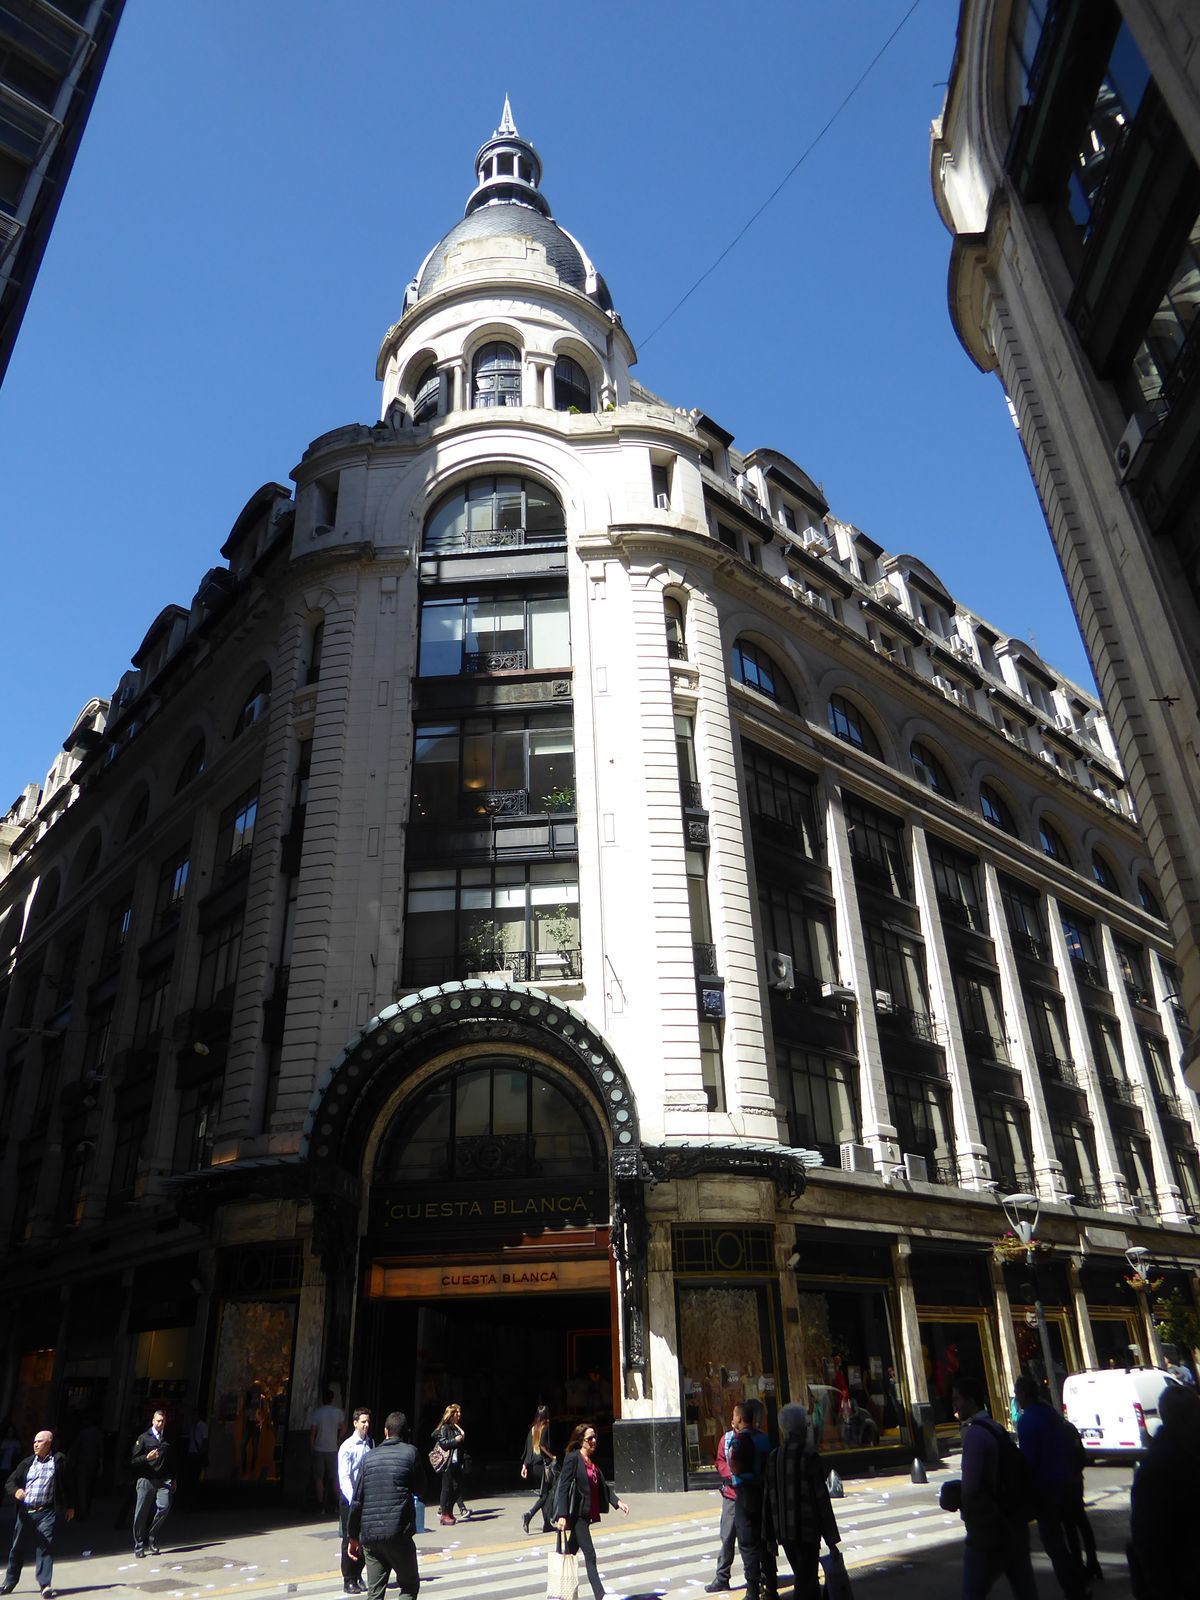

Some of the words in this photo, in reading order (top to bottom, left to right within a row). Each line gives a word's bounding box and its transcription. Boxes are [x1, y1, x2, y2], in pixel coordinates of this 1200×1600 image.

[390, 1201, 483, 1220] CUESTA
[493, 1196, 588, 1215] BLANCA
[441, 1274, 497, 1286] CUESTA
[502, 1271, 558, 1284] BLANCA
